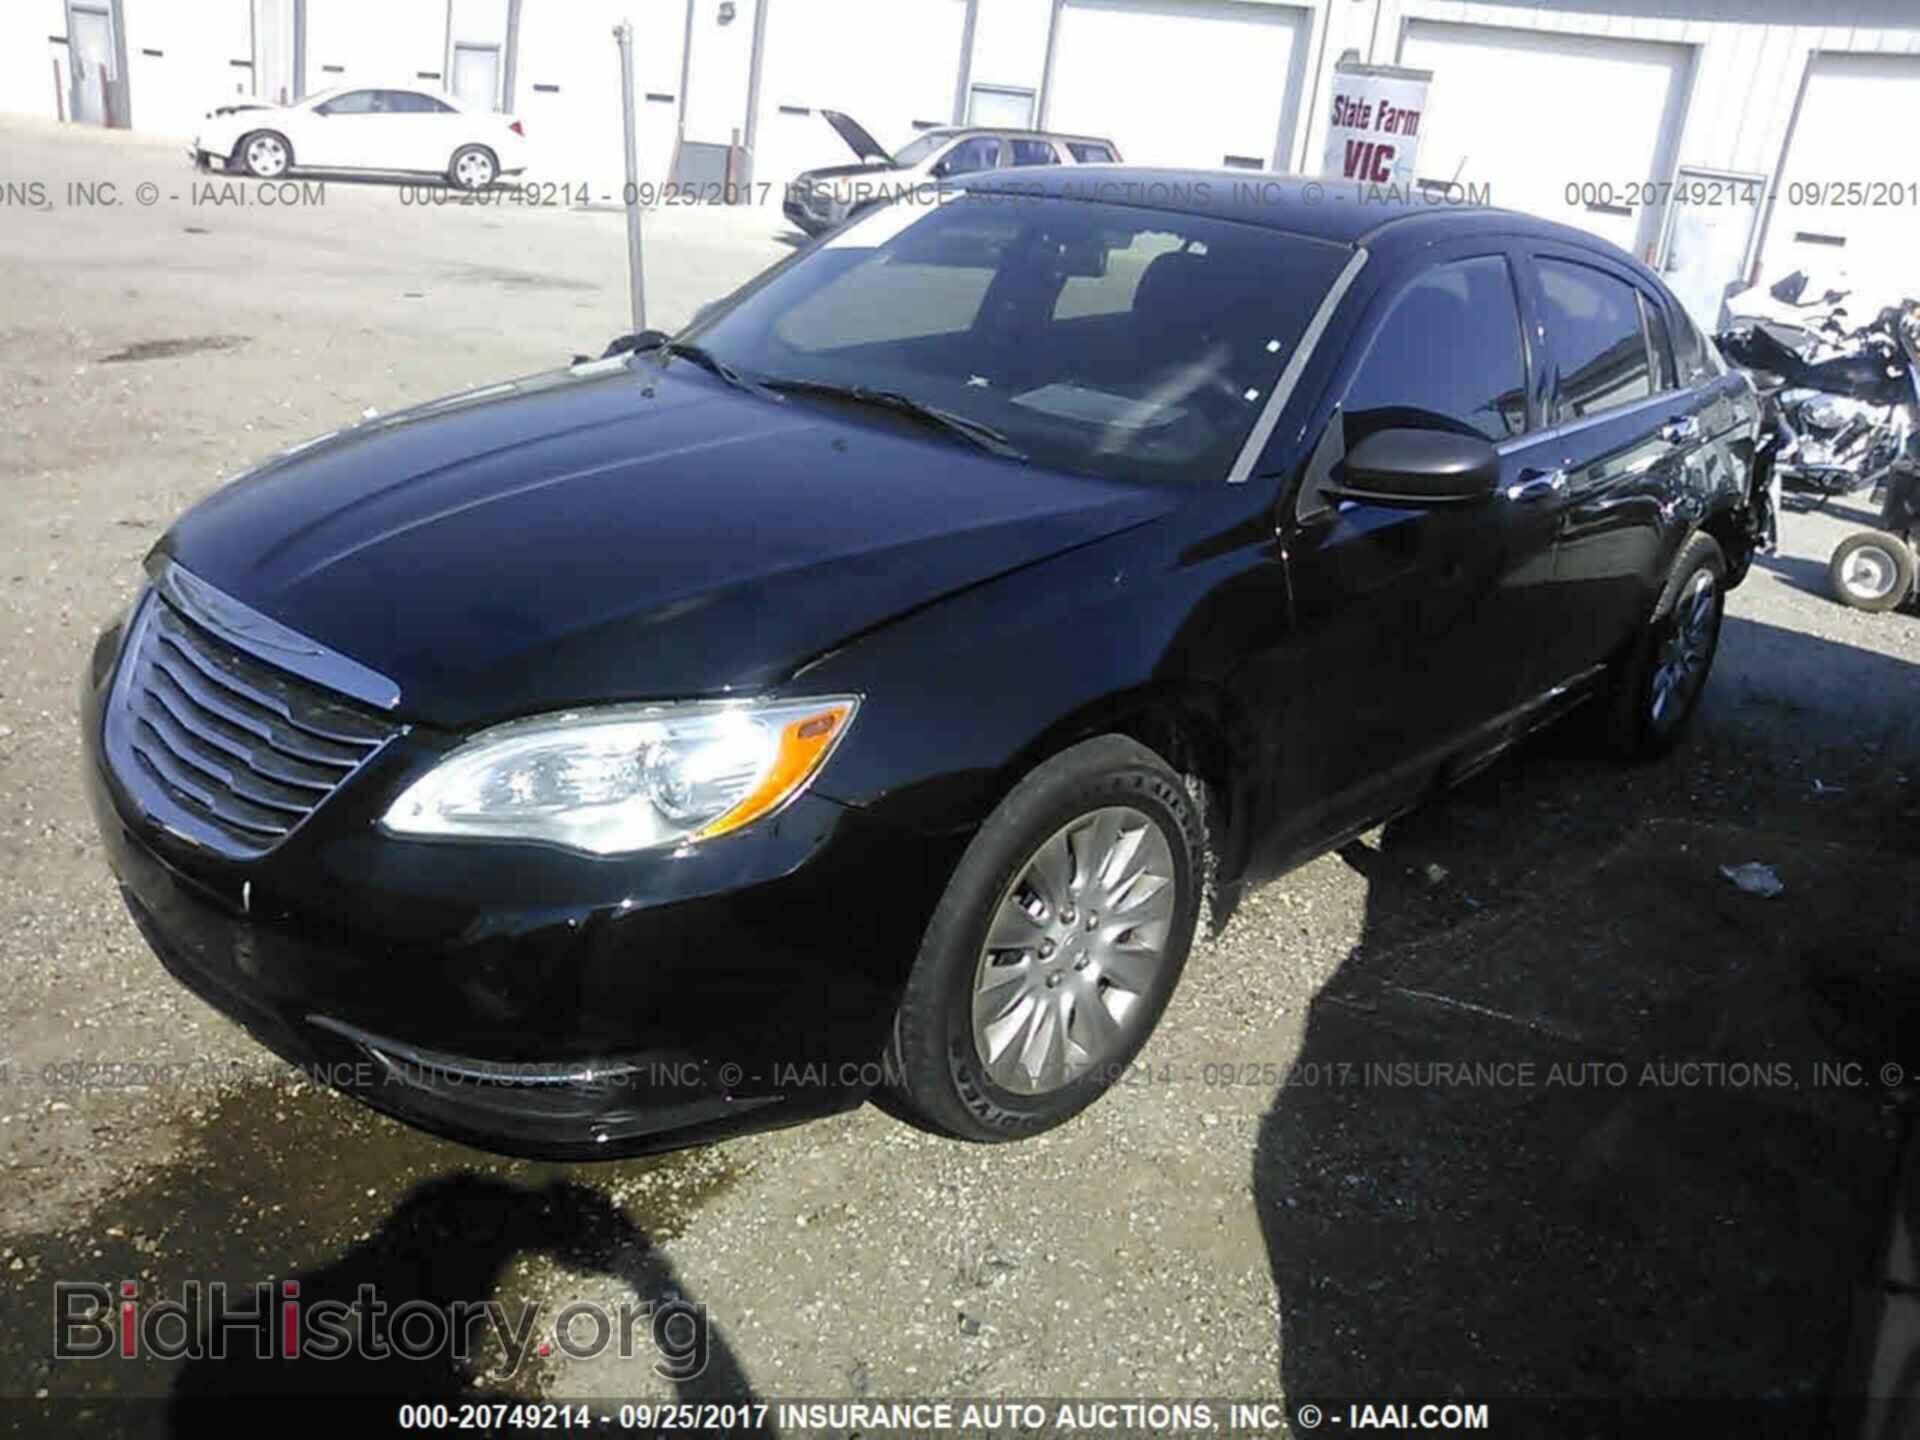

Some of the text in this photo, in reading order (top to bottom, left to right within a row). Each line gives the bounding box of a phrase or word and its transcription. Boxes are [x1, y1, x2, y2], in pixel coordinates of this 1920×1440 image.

[1332, 94, 1420, 136] State Farm
[1344, 140, 1395, 182] VIC
